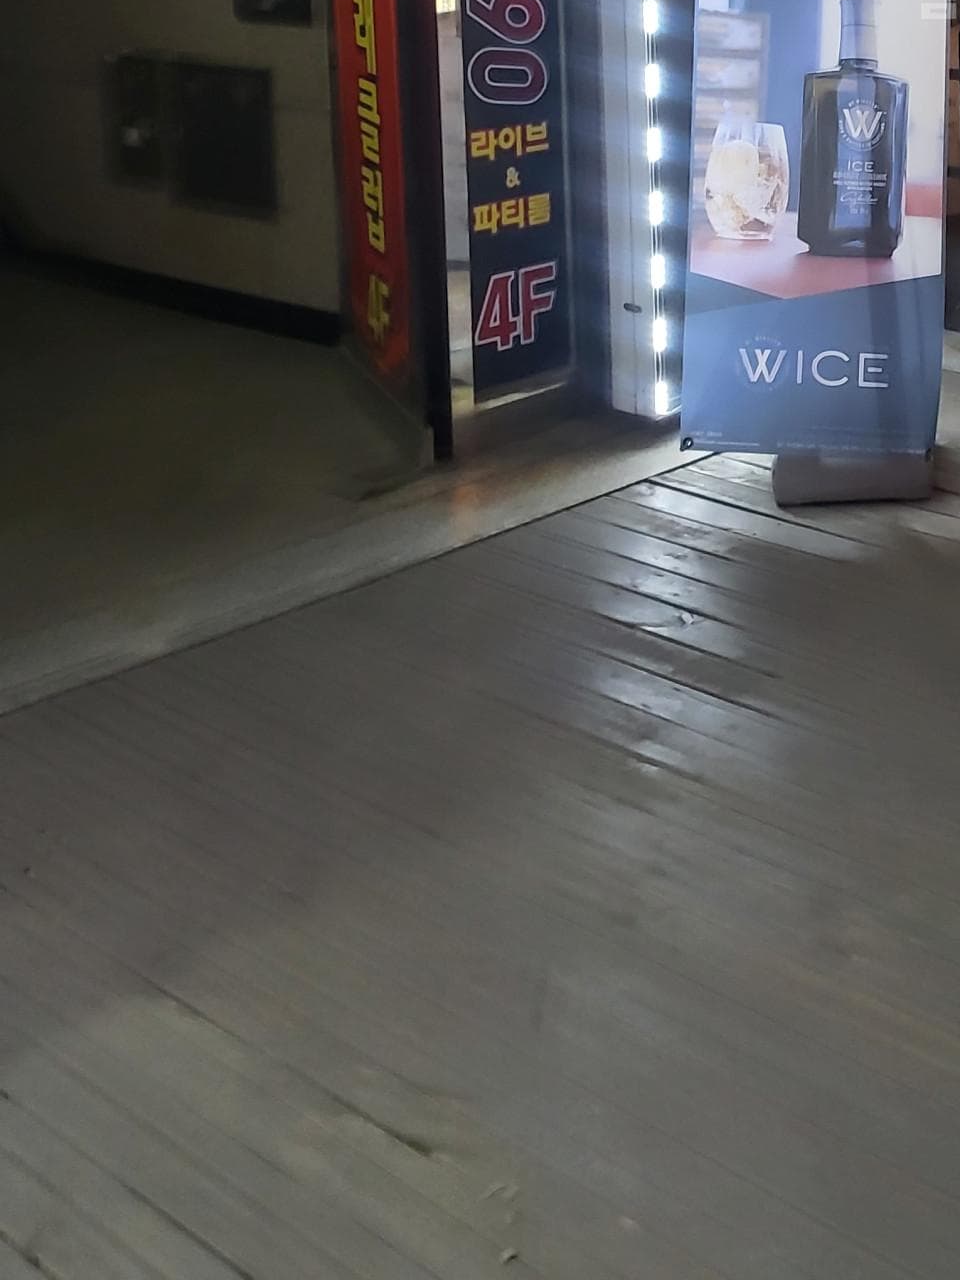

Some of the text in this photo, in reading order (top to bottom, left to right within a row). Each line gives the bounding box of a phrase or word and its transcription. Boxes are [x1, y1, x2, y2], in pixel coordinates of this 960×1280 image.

[471, 122, 549, 161] 라이브
[506, 167, 520, 188] &
[847, 160, 875, 173] ICE
[473, 192, 550, 234] 파티룸
[475, 261, 558, 352] 4F
